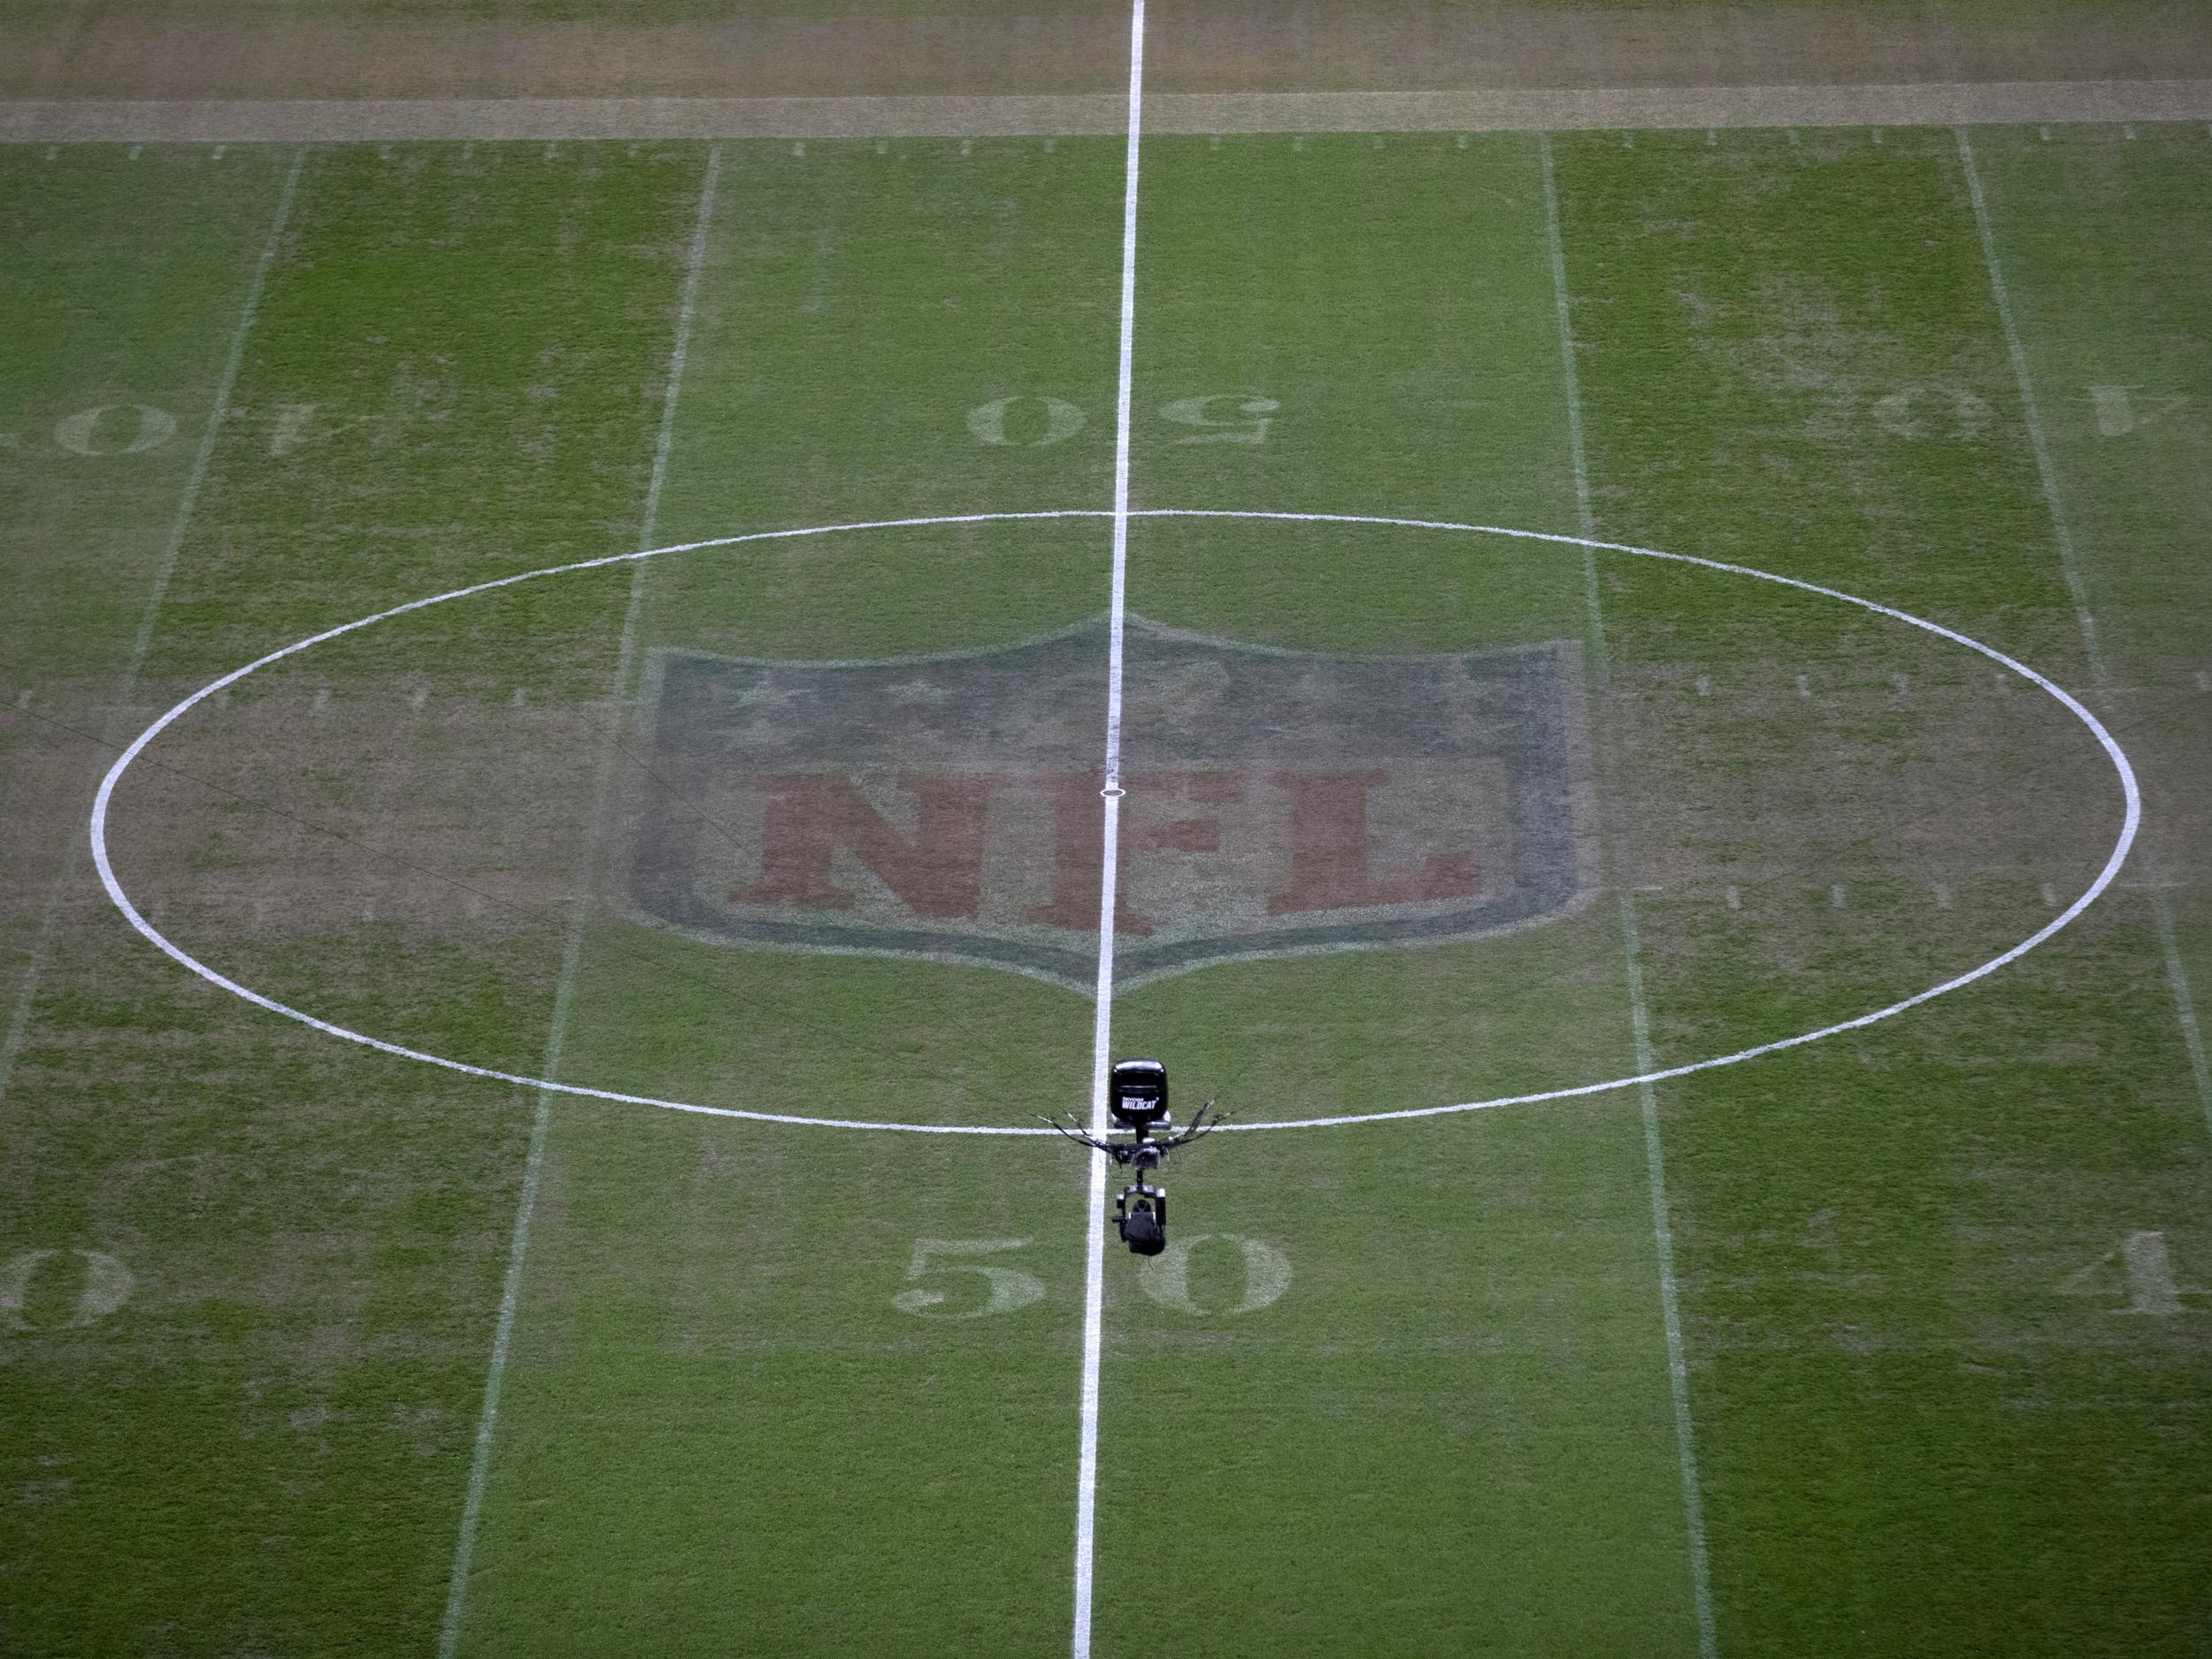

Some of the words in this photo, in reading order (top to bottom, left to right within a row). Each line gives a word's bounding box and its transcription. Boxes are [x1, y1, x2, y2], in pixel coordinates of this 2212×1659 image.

[726, 769, 1484, 936] NFL
[1122, 1100, 1157, 1110] WILDCAT
[892, 1234, 1293, 1319] 50
